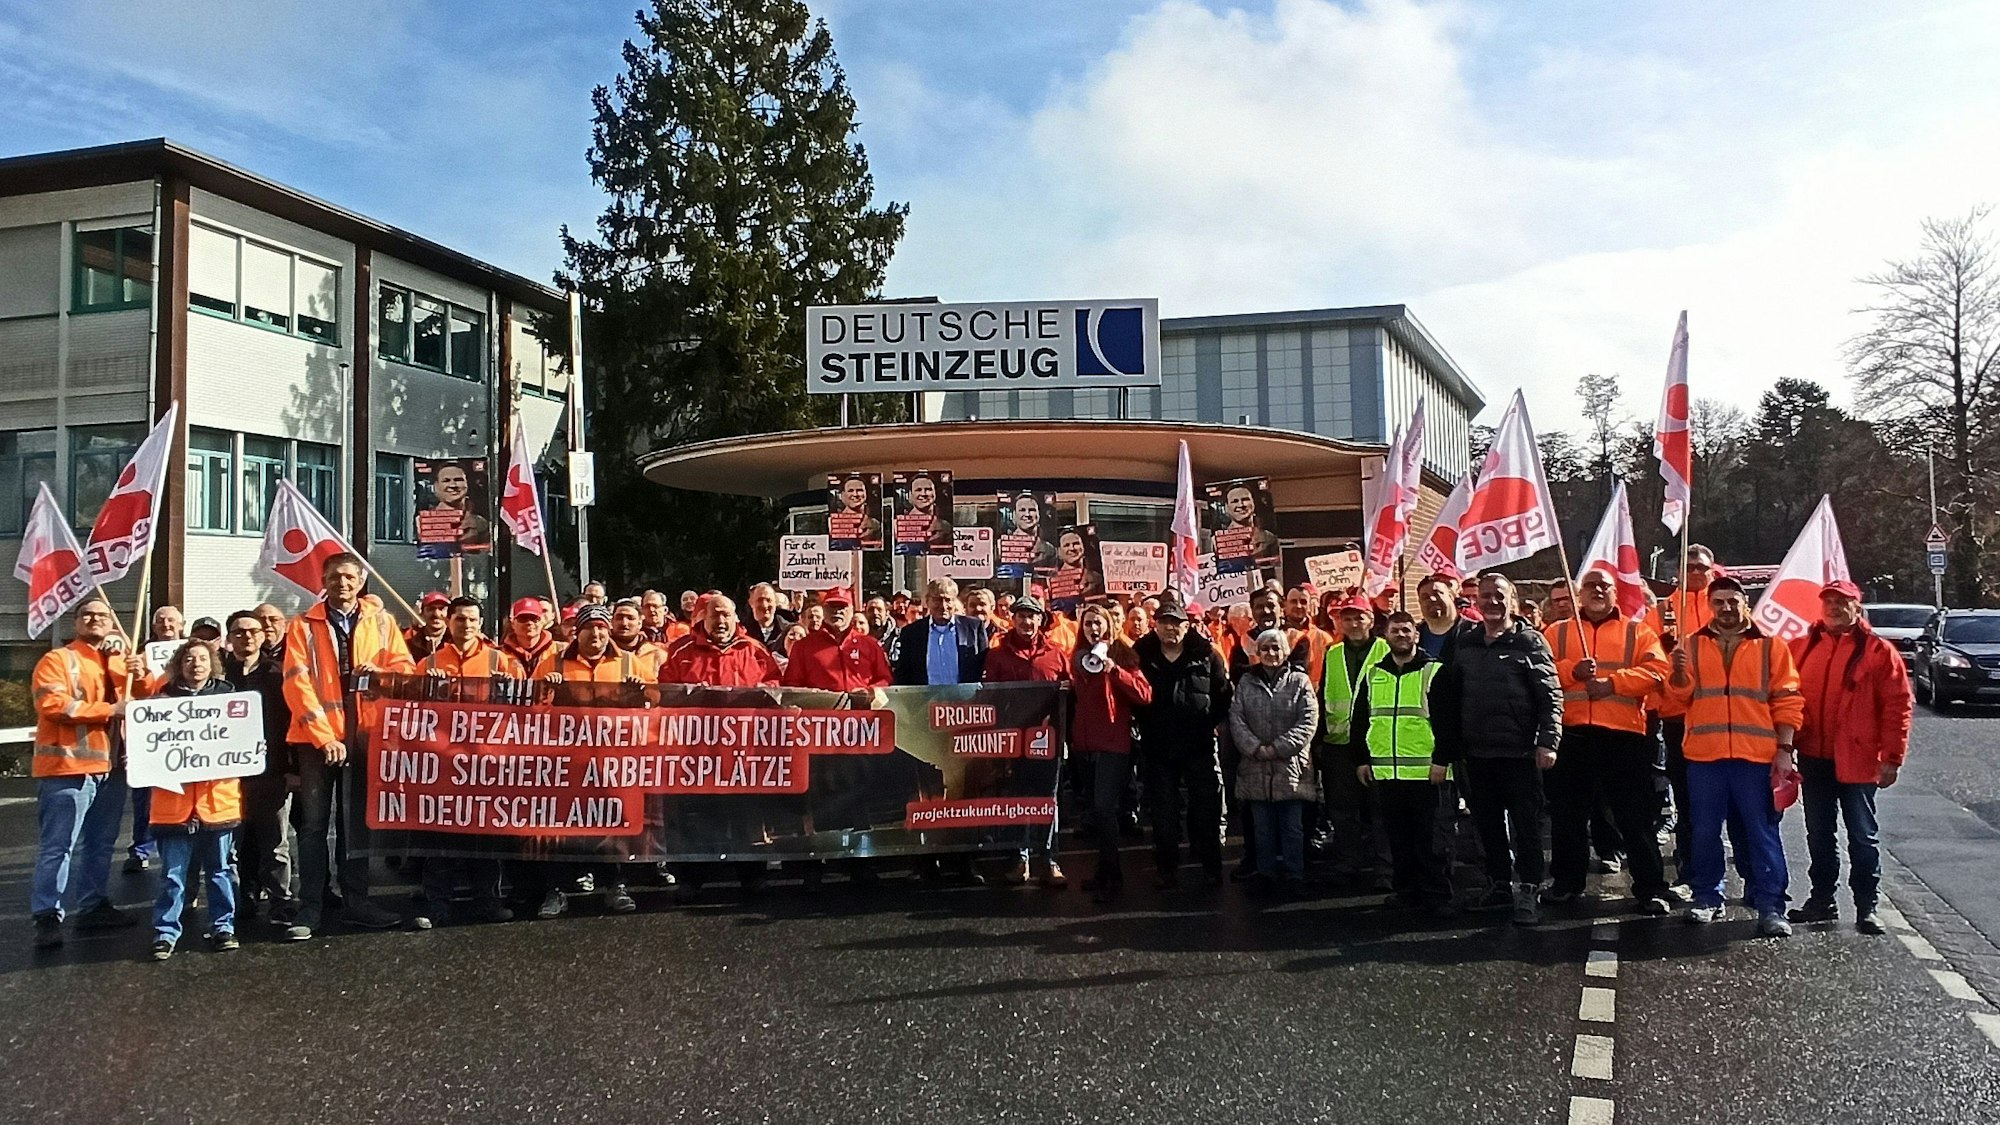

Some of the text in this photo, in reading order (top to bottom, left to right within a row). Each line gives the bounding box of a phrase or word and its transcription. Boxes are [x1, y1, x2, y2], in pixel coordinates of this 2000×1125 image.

[821, 309, 1060, 344] DEUTSCHE
[820, 347, 1059, 383] STEINZEUG
[787, 553, 826, 566] Zukunft
[1127, 582, 1147, 591] PLUS
[152, 646, 169, 660] Es
[133, 700, 221, 723] Ohne Strom
[935, 704, 994, 727] PROJEKT
[146, 723, 230, 753] gehen die
[382, 702, 880, 748] FÜR BEZAHLBAREN INDUSTRIESTROM
[953, 732, 1018, 754] ZUKUNFT
[165, 743, 210, 772] Öfen
[379, 750, 792, 788] UND SICHERE ARBEITSPLÄTZE
[378, 790, 631, 829] IN DEUTSCHLAND.
[912, 801, 1055, 823] projektzukunft.igbce.de
